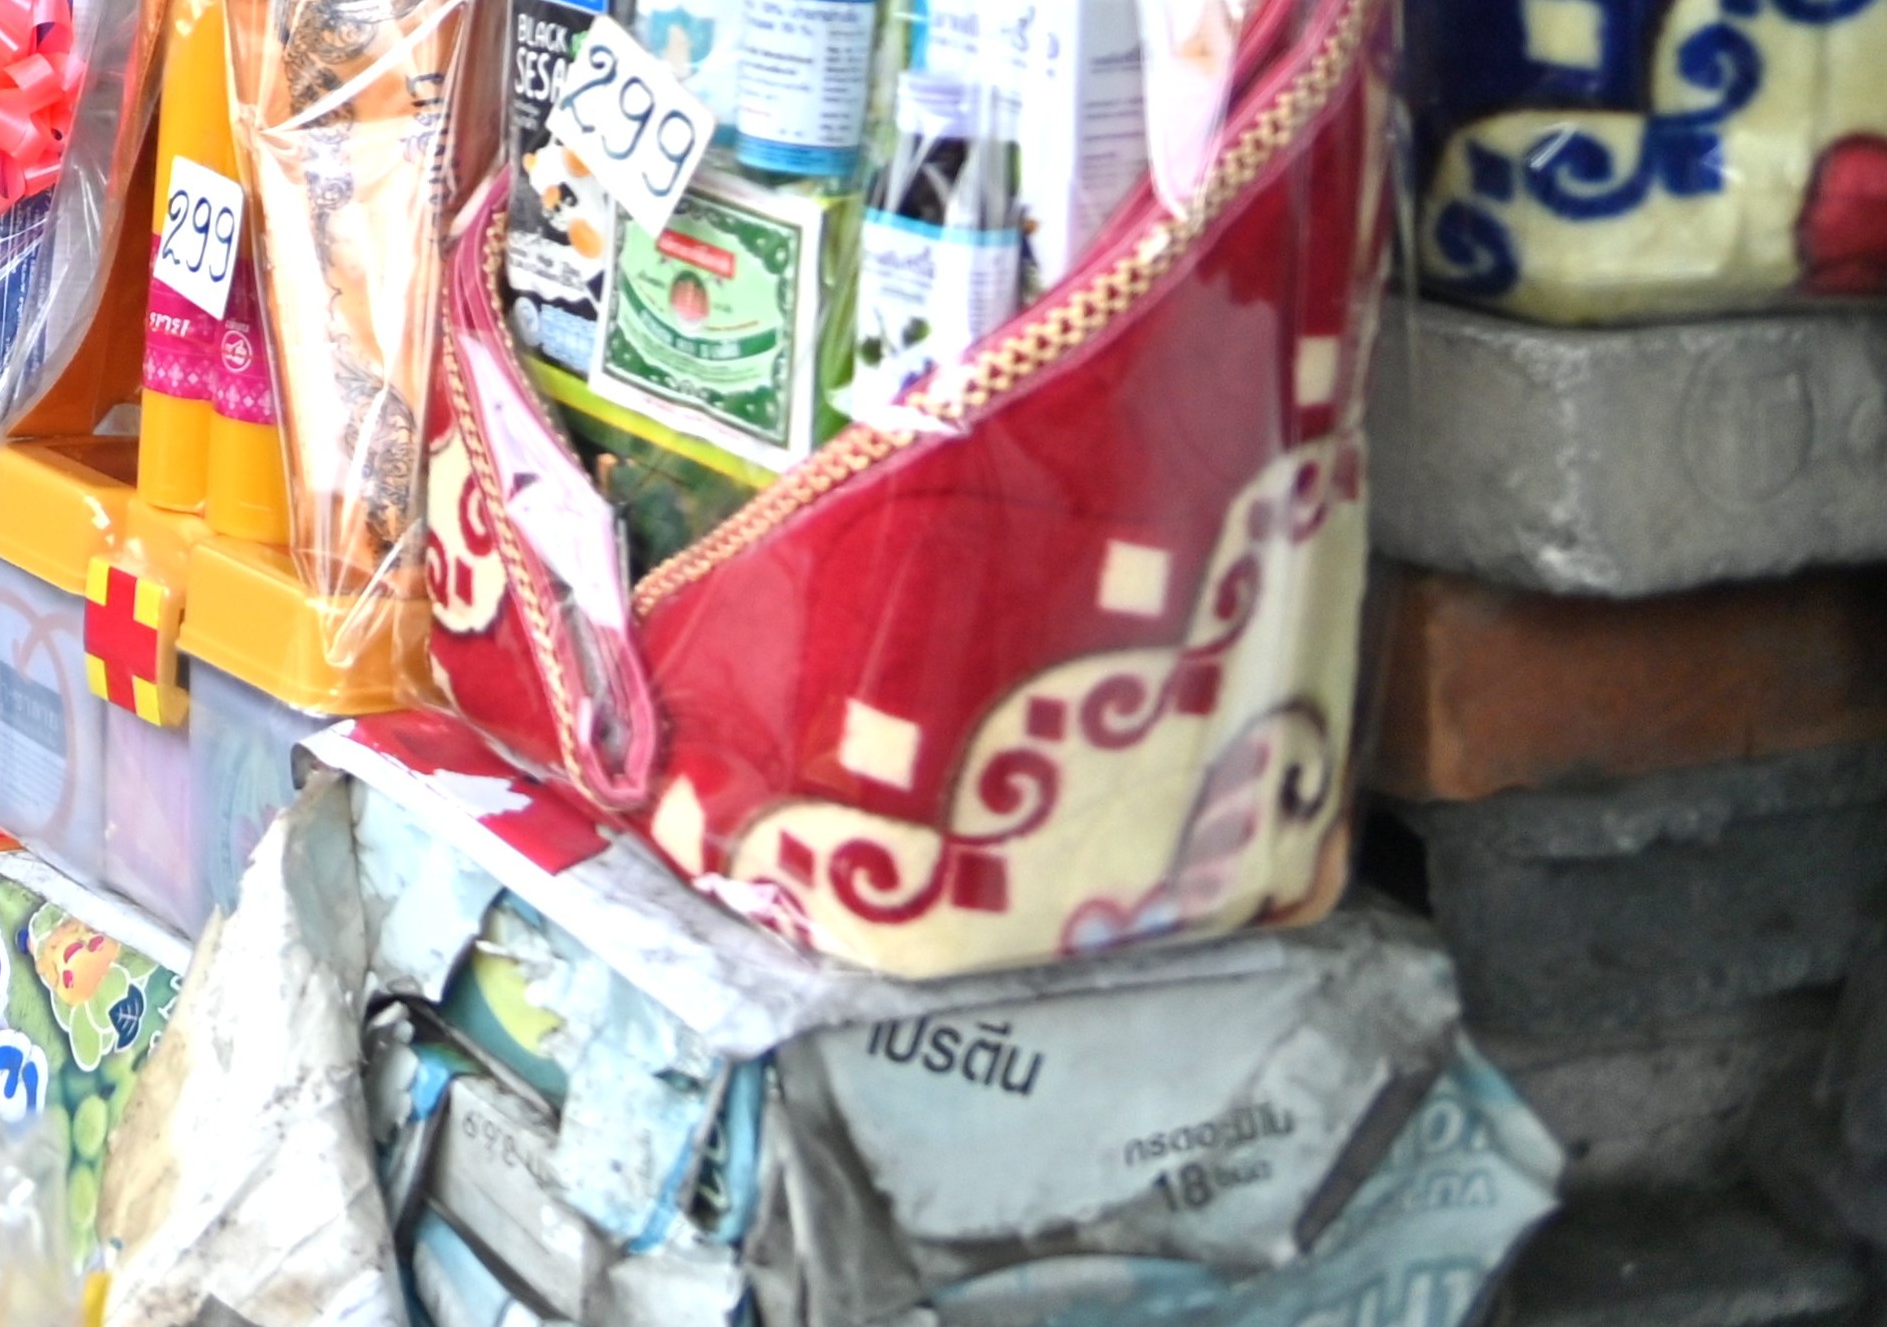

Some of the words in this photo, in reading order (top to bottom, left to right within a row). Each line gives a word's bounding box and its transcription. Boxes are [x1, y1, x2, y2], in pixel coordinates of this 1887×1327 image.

[517, 12, 568, 53] BLACK
[559, 43, 696, 198] 299
[161, 189, 235, 283] 299
[1151, 1163, 1214, 1214] 18
